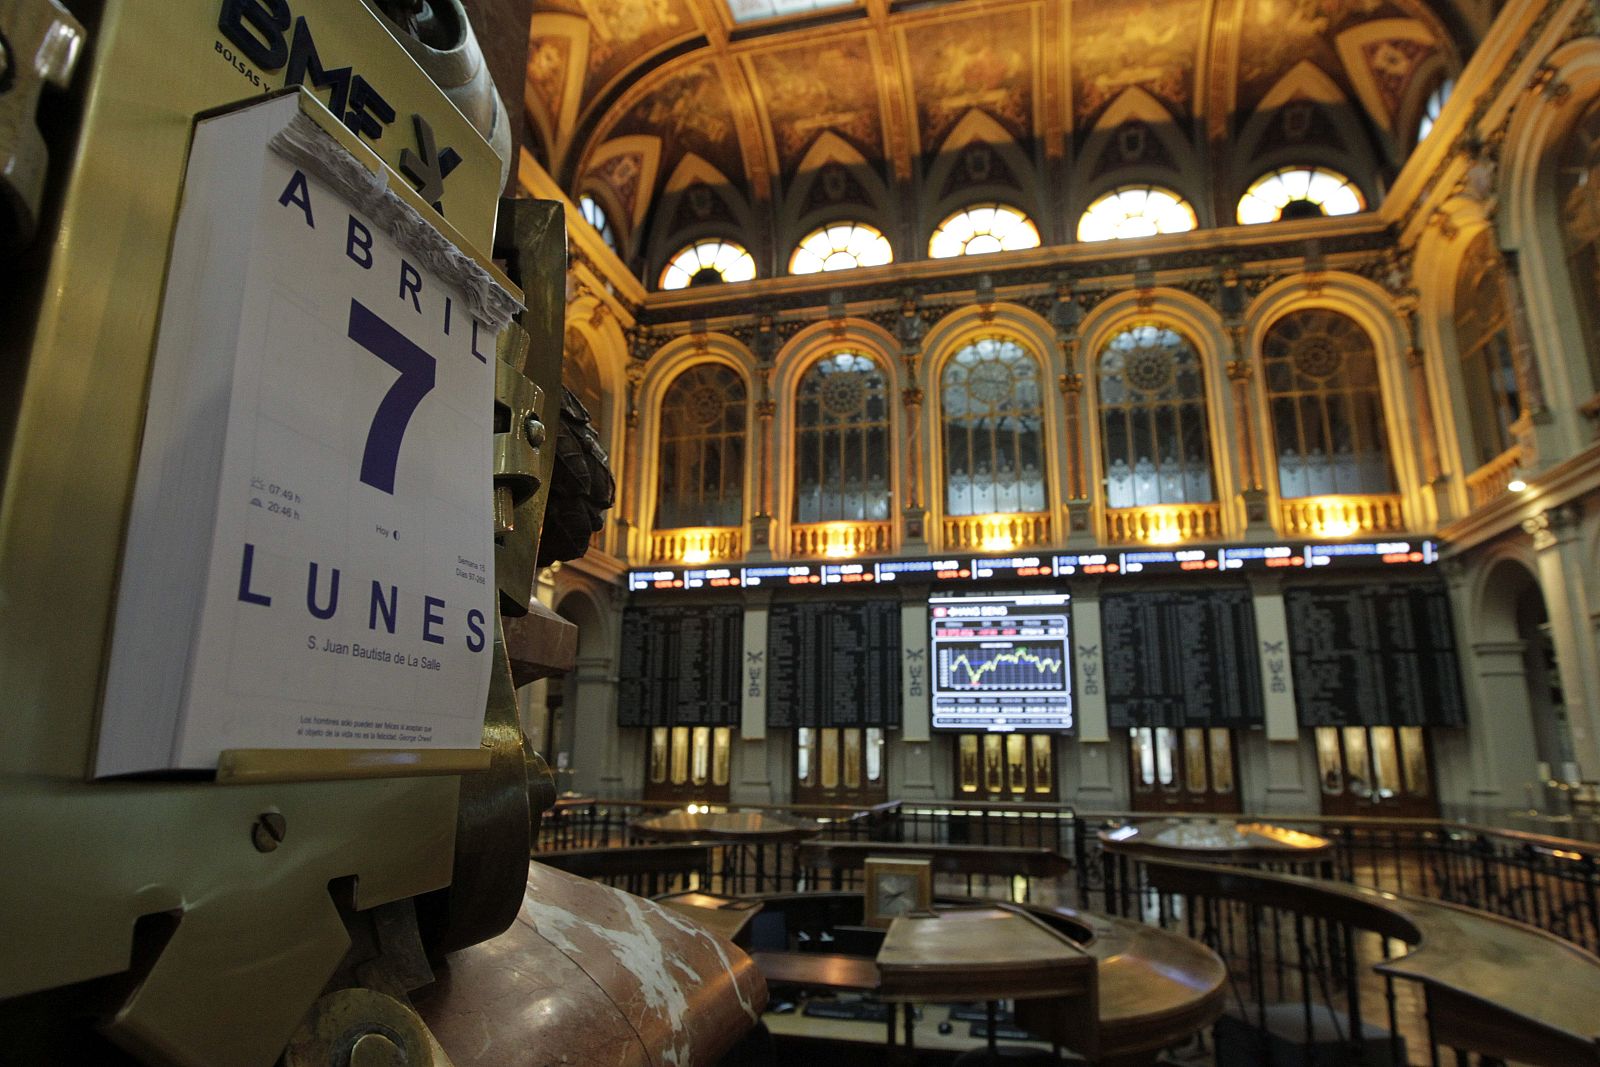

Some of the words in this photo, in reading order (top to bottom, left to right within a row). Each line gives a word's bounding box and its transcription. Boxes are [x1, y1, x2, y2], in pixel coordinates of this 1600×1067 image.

[214, 40, 260, 87] BOLSAS
[278, 169, 487, 364] ABRIL
[348, 297, 436, 496] 7
[268, 483, 294, 501] 07:49
[294, 493, 302, 504] h
[293, 510, 300, 520] h
[237, 543, 486, 653] LUNES
[307, 635, 319, 650] S.
[323, 639, 349, 655] Juan
[352, 643, 391, 663] Bautista
[394, 652, 405, 665] de
[408, 654, 418, 668] La
[421, 656, 441, 671] Salle
